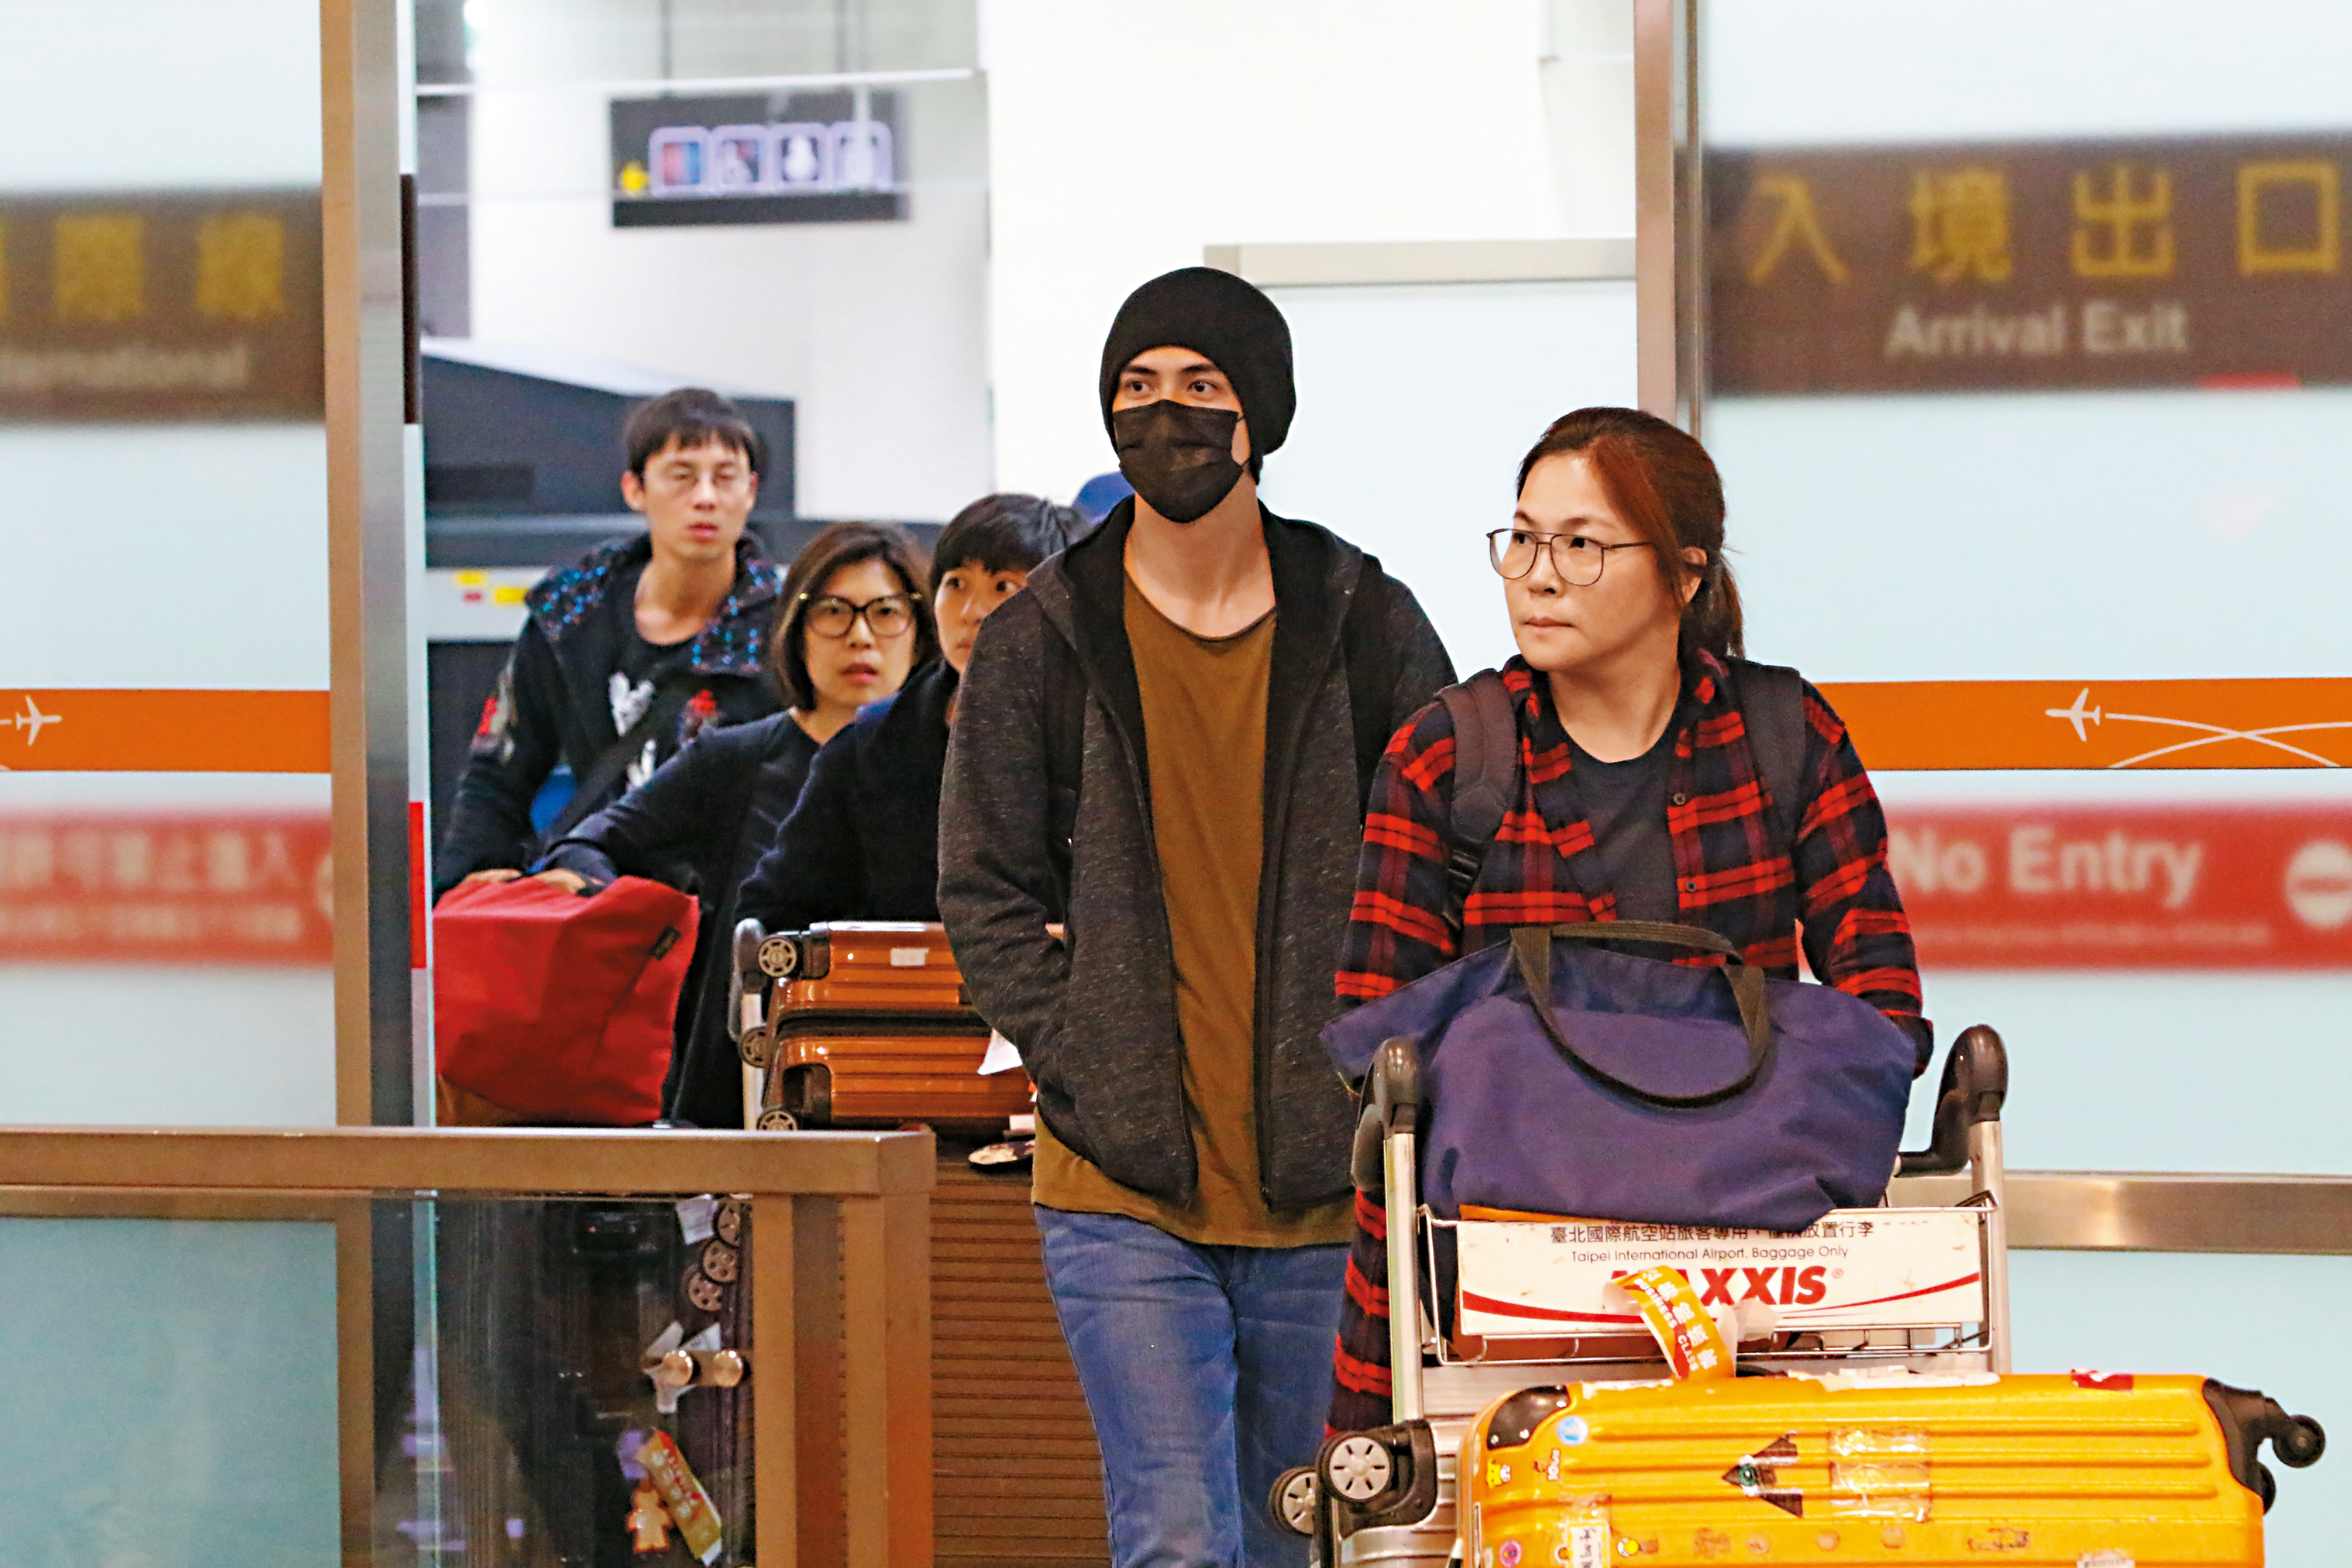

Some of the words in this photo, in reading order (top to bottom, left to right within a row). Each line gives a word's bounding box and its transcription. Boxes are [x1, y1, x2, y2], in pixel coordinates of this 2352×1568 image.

[1744, 159, 2338, 287] 入境出口
[1885, 302, 2063, 356] Arrival
[2082, 297, 2189, 354] Exit
[1890, 824, 1988, 893] No
[2008, 824, 2203, 910] Entry
[1572, 1250, 1611, 1264] Taipei
[1615, 1249, 1698, 1261] International
[1702, 1248, 1747, 1260] Airport,
[1752, 1247, 1814, 1260] Baggage
[1819, 1246, 1849, 1258] Only
[1611, 1265, 1827, 1307] XXIS
[1634, 1278, 1678, 1329] BUSINESS
[1678, 1335, 1699, 1371] CLASS
